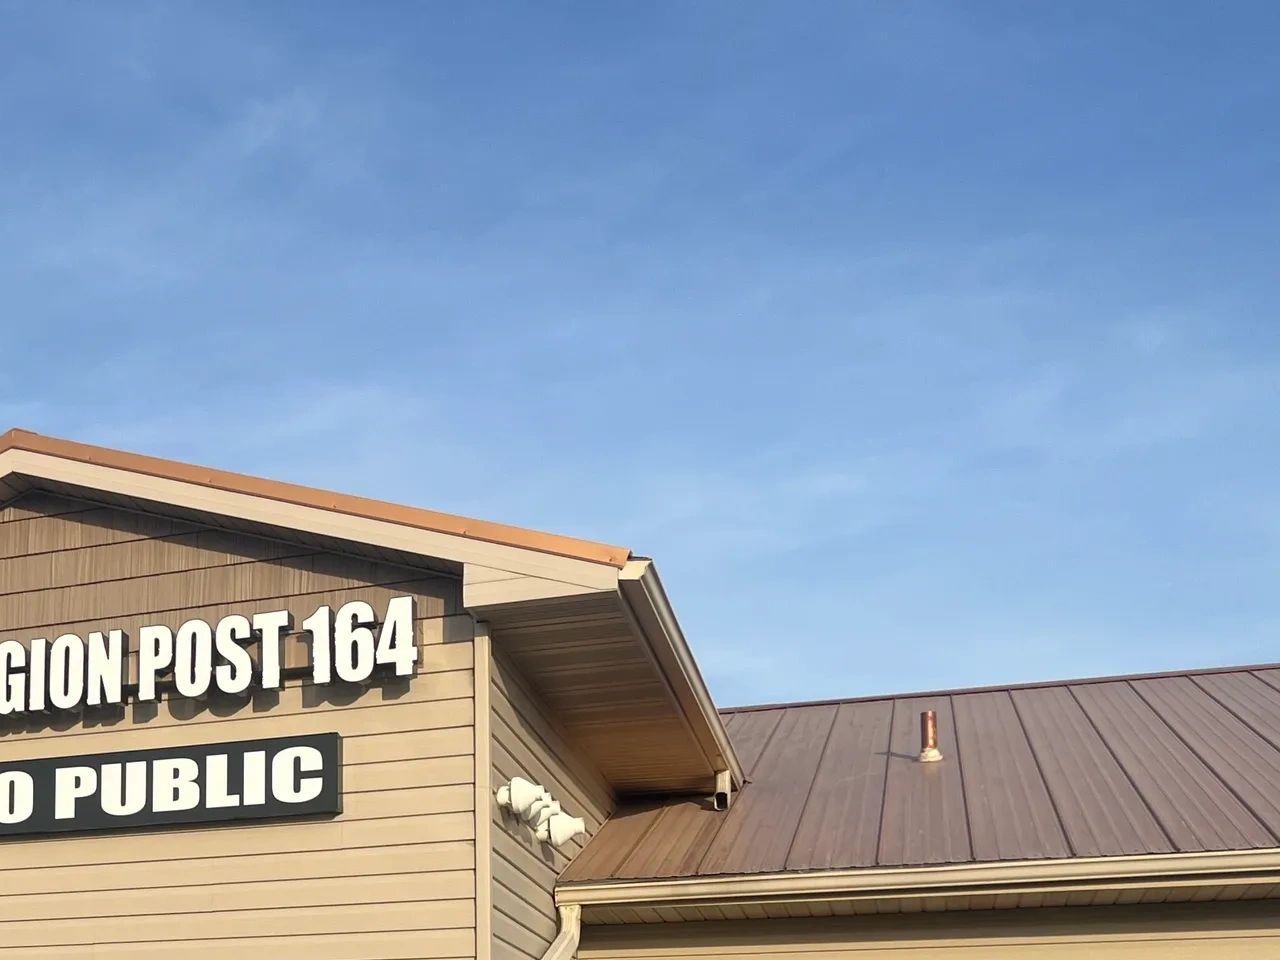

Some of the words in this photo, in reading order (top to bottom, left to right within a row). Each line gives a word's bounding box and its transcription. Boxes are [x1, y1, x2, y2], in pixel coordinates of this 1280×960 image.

[138, 609, 290, 701] POST
[302, 596, 418, 684] 164
[54, 746, 324, 820] PUBLIC
